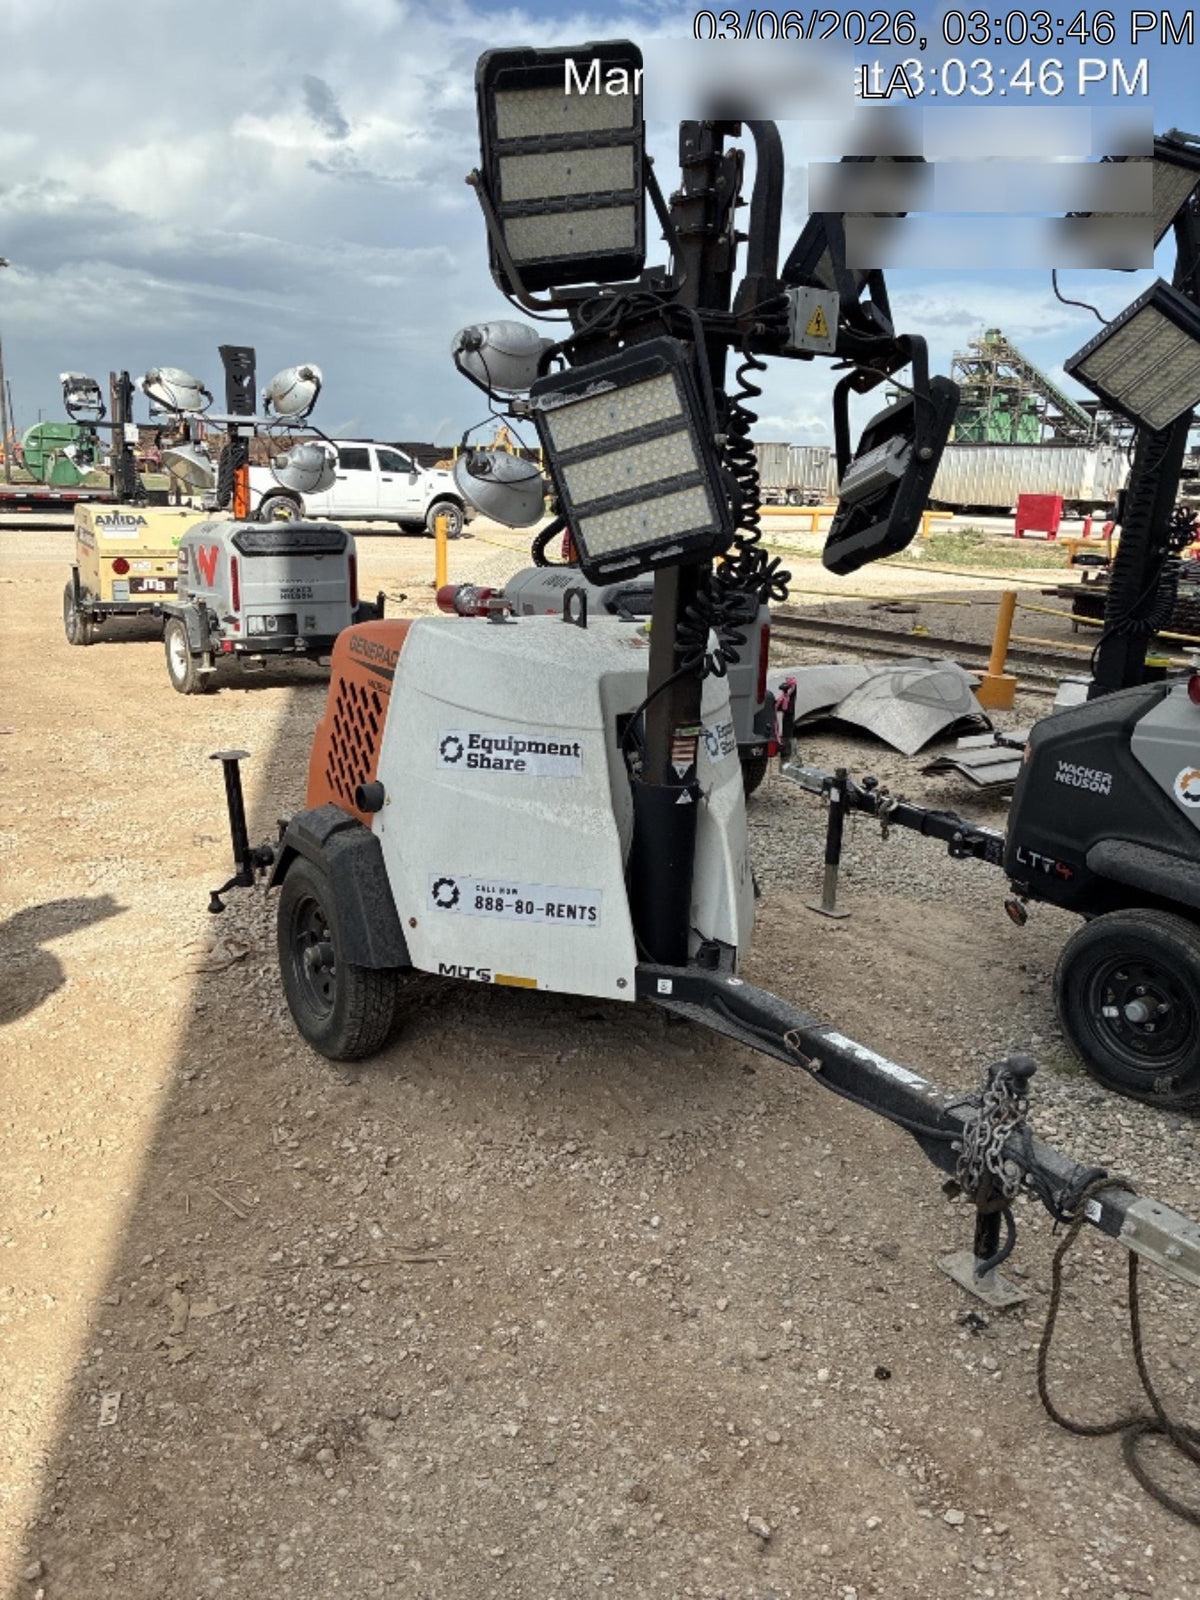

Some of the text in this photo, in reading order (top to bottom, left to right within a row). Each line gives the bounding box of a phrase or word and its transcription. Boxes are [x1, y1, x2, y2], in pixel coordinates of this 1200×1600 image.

[95, 514, 147, 525] AMIDA
[138, 578, 166, 591] JTB
[468, 733, 581, 758] Equipment
[467, 753, 526, 771] Share
[1057, 760, 1112, 785] WACKER
[1055, 770, 1111, 795] NEUSON
[474, 895, 597, 921] 888-80-RENTS
